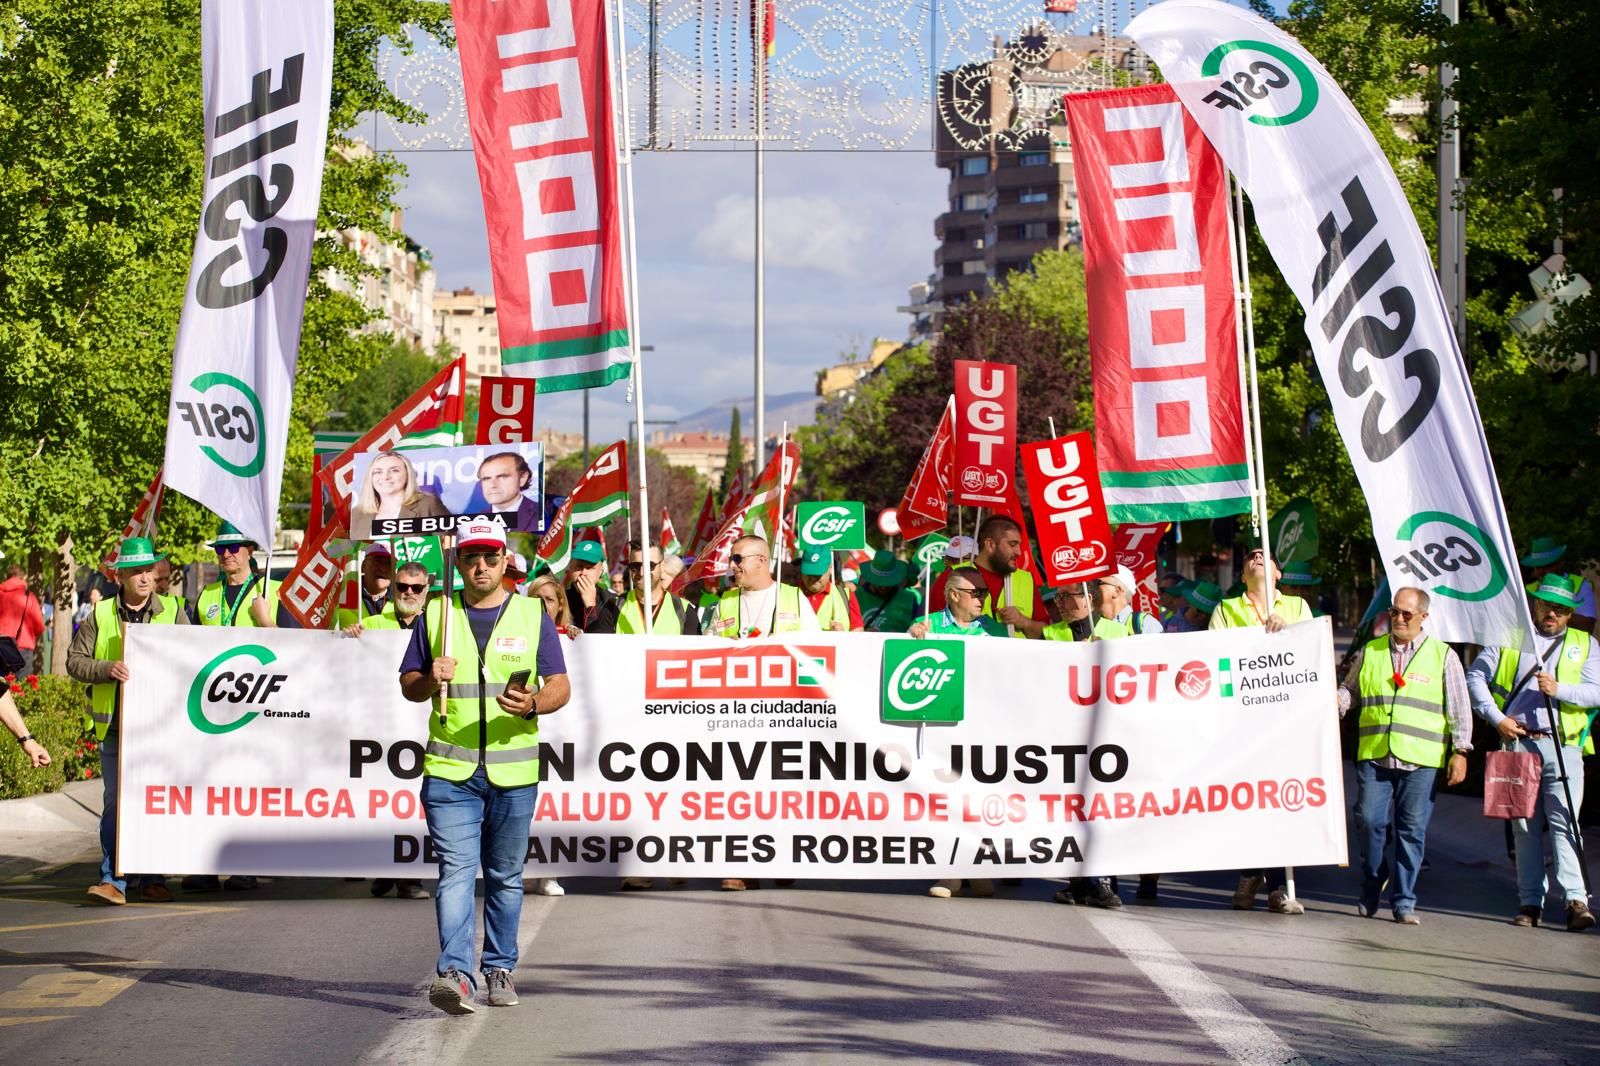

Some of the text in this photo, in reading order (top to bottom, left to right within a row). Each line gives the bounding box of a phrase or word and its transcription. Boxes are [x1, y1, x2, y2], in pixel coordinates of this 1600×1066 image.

[488, 384, 524, 445] UG
[966, 368, 1005, 466] UGT
[1036, 441, 1094, 543] UGT
[381, 519, 414, 534] SE
[812, 518, 857, 533] CSIF
[501, 654, 521, 663] alsa
[1238, 652, 1295, 671] FeSMC
[656, 656, 792, 689] CCOO
[901, 668, 956, 691] CSIF
[1239, 669, 1319, 691] Andalucía
[207, 671, 288, 704] CSIF
[1067, 663, 1169, 706] UGT
[644, 700, 837, 714] servicios a la ciudadanía
[1241, 691, 1290, 706] Granada
[263, 708, 311, 719] Granada
[707, 717, 764, 731] granada
[349, 739, 1129, 784] PO N CONVENIO JUSTO
[145, 777, 1327, 827] EN HUELGA PO ALUD Y SEGURIDAD DE L@S TRABAJADOR@S
[523, 834, 776, 864] ANSPORTES
[792, 834, 936, 865] ROBER
[949, 837, 960, 865] /
[973, 836, 1084, 865] ALSA
